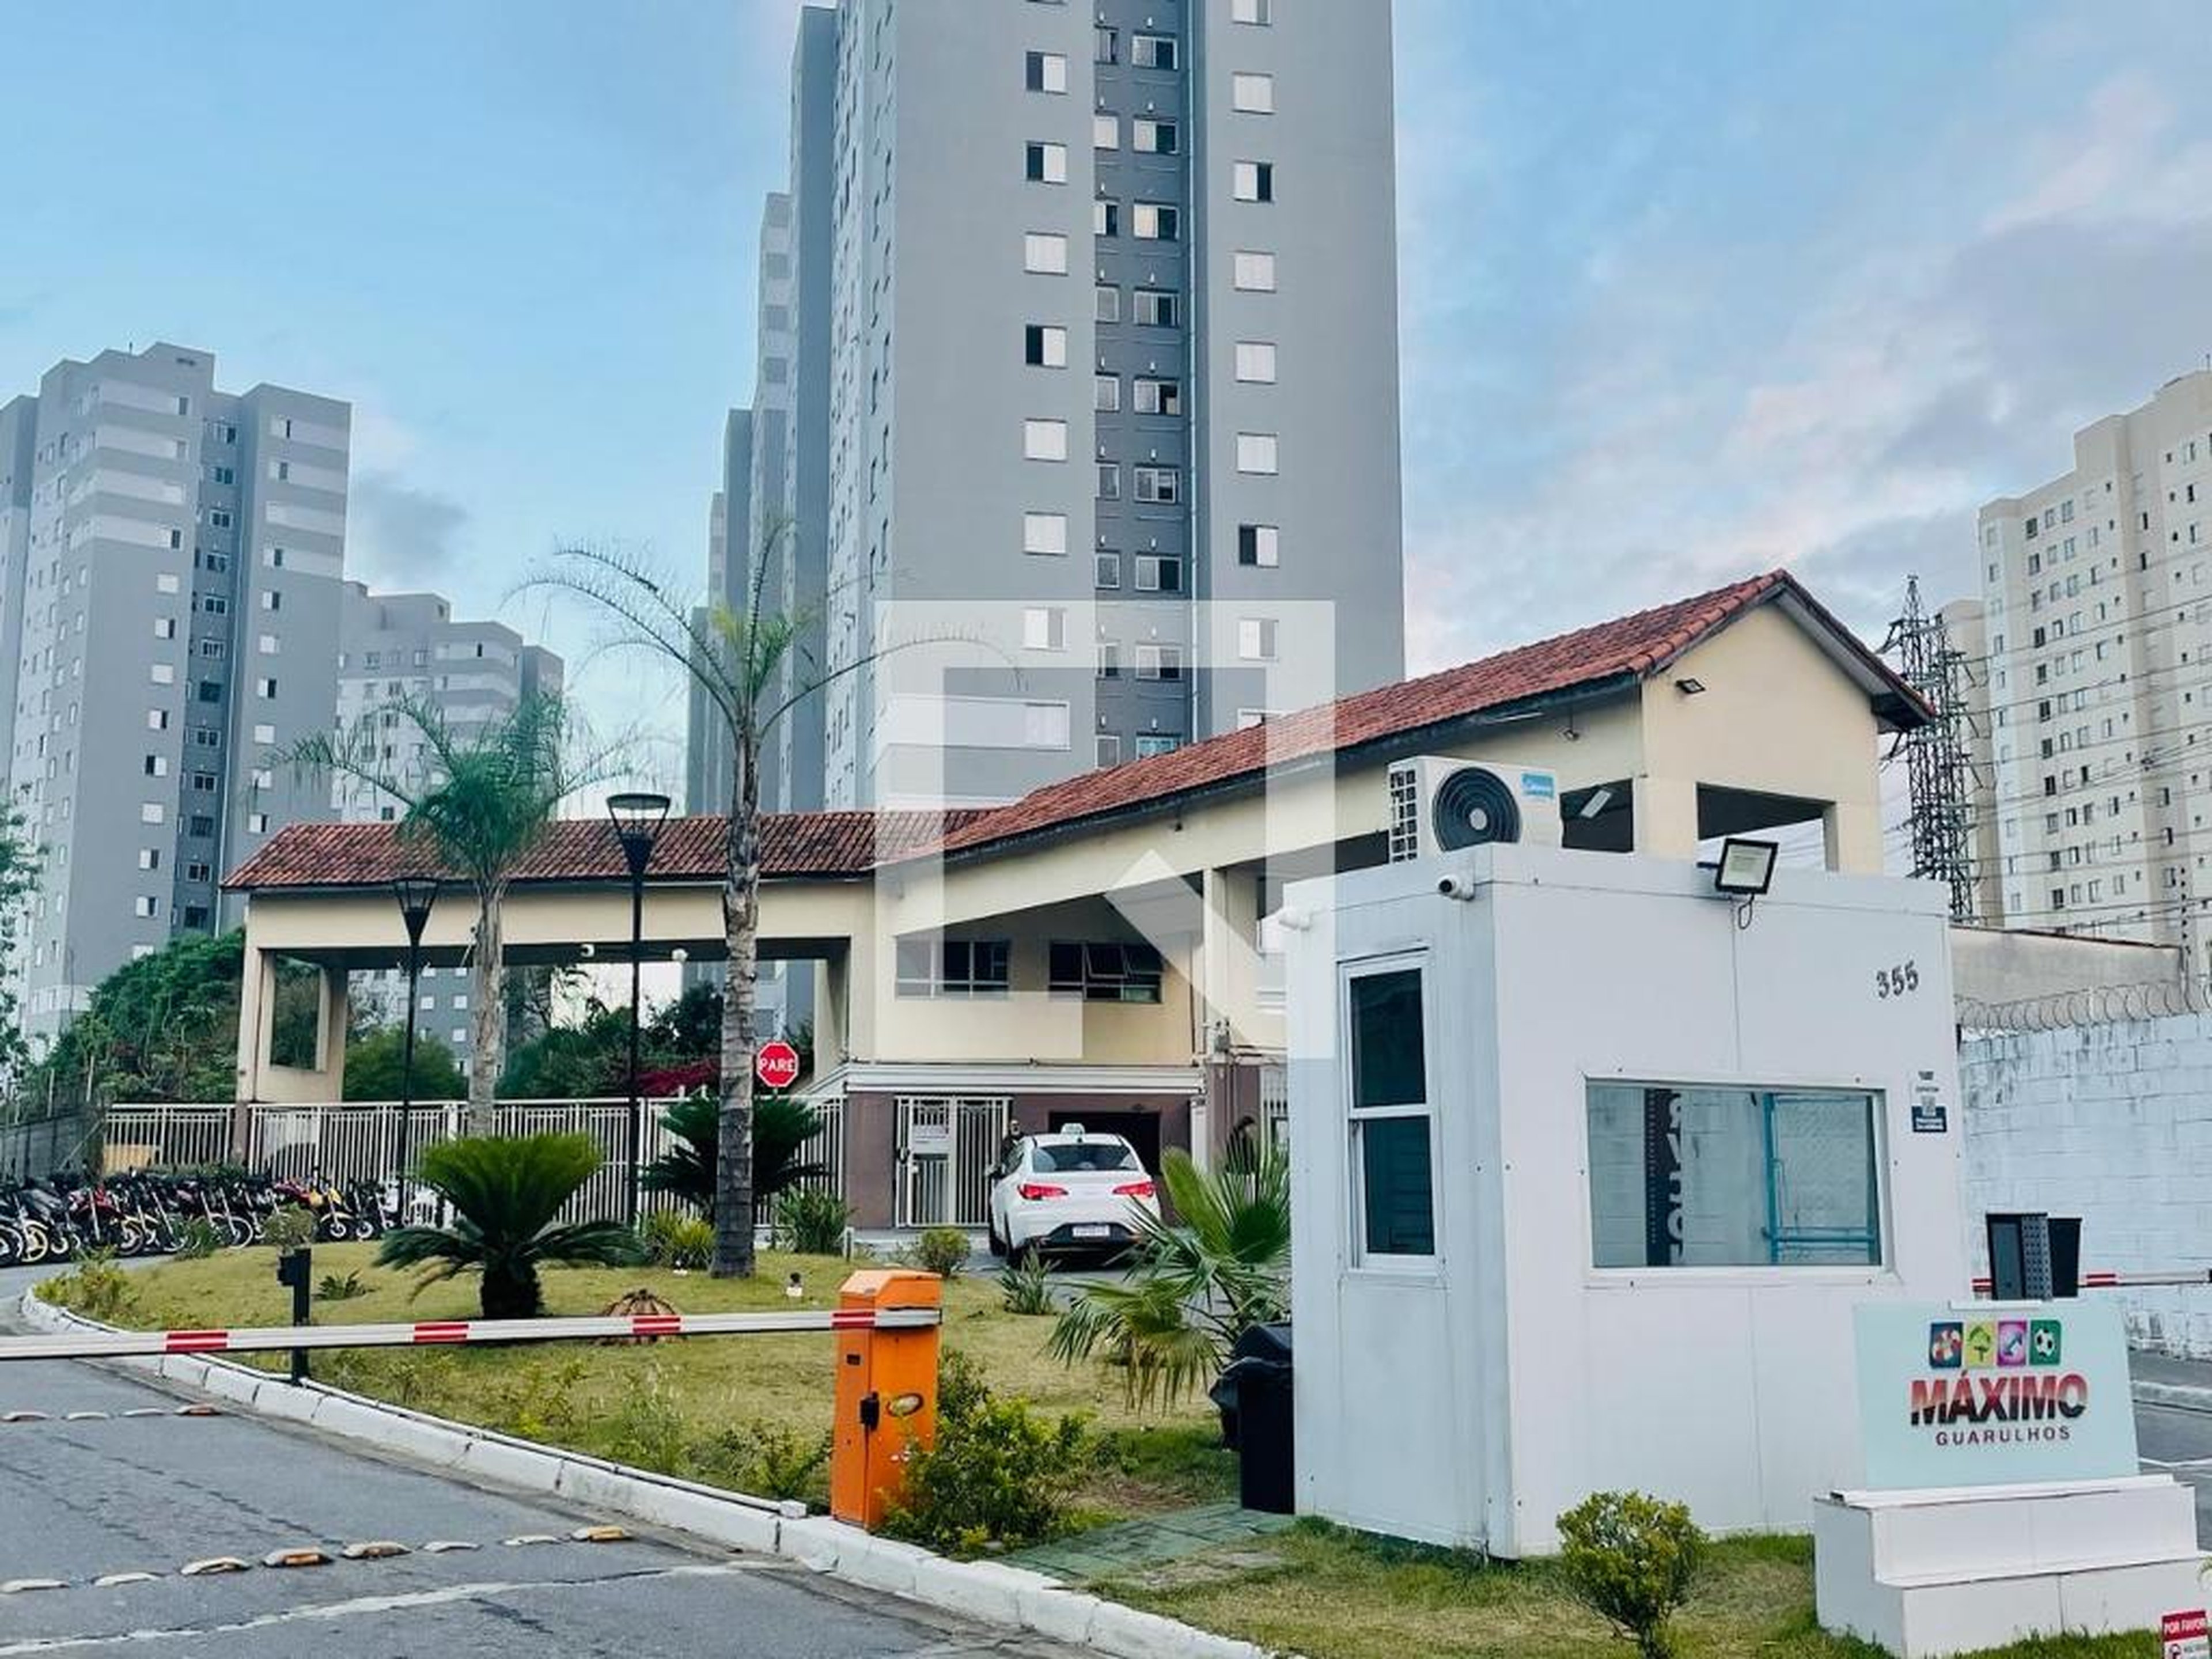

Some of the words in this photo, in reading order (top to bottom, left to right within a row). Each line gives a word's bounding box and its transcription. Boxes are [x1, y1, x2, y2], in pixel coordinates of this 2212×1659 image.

[1876, 960, 1919, 999] 355
[759, 1058, 795, 1071] PARE
[1910, 1369, 2088, 1426] MÁXIMO
[1936, 1425, 2070, 1446] GUARULHOS
